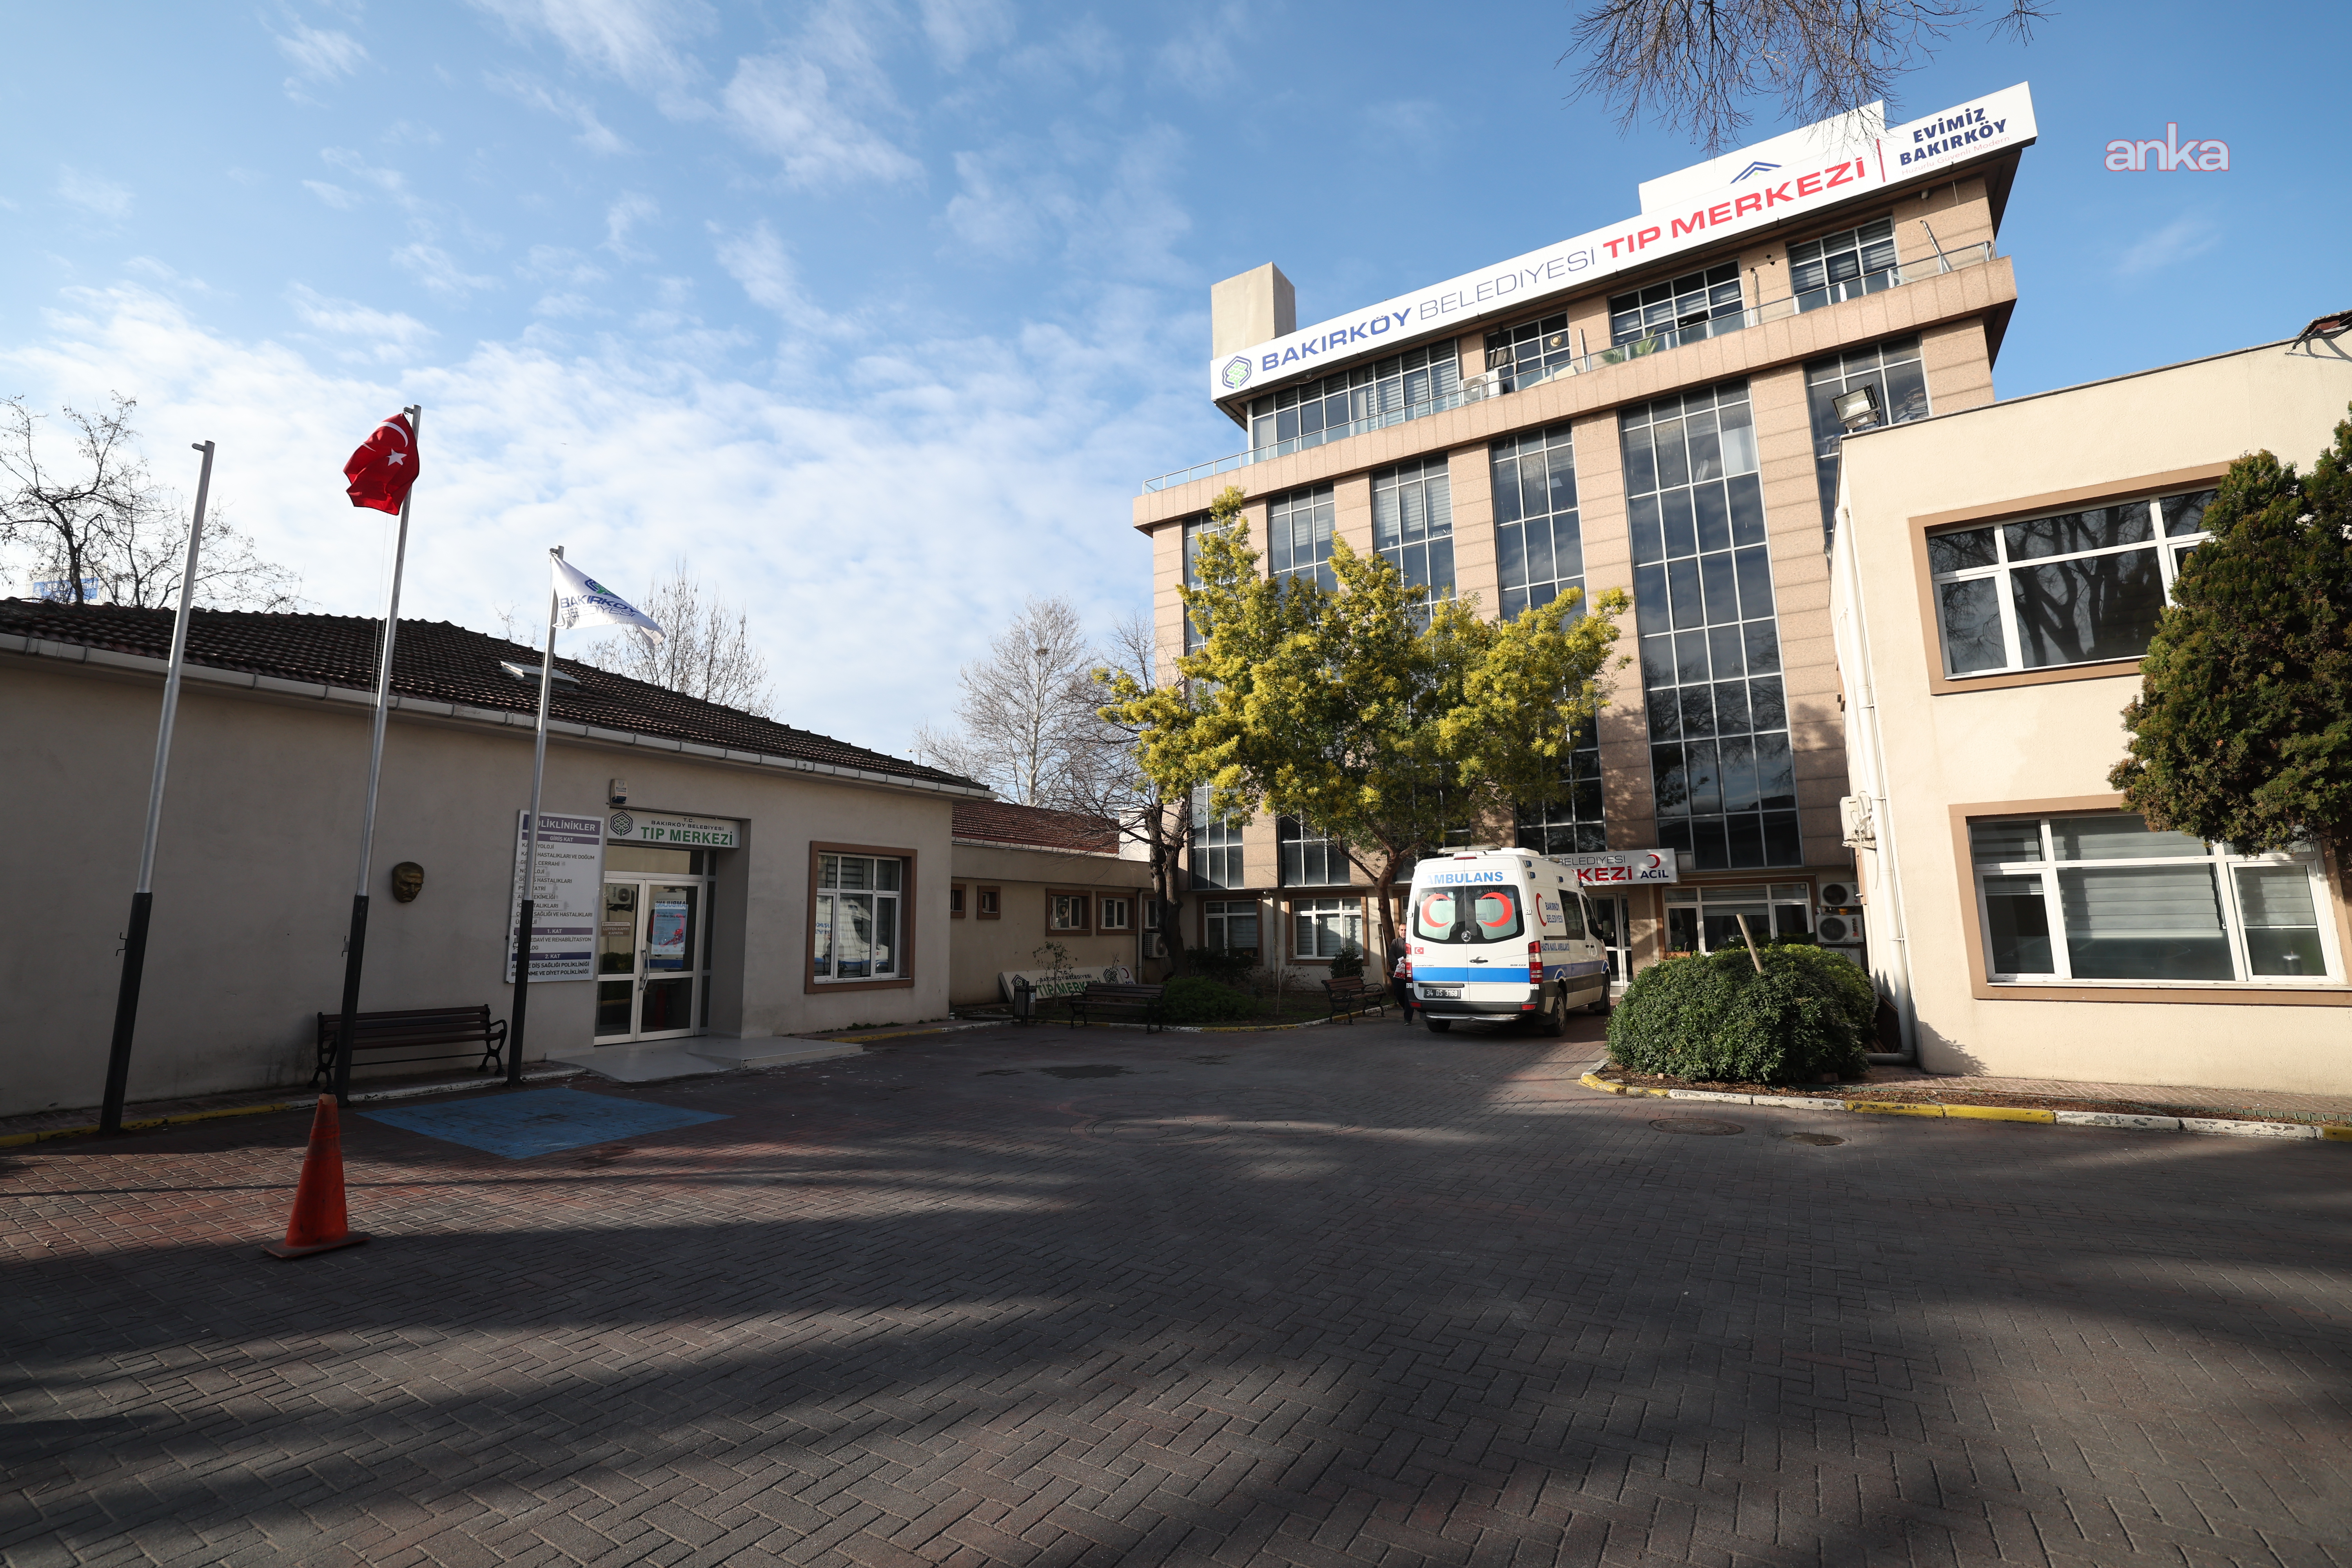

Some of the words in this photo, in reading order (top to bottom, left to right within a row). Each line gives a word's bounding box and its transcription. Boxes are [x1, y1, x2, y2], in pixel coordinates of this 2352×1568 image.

[1913, 108, 1986, 143] EVİMİZ
[1900, 118, 2007, 166] BAKIRKÖY
[1902, 162, 1935, 176] Huzurlu
[1937, 149, 1971, 163] Güvenli
[1974, 136, 2010, 151] Modern
[1262, 307, 1412, 372] BAKIRKÖY
[1420, 247, 1595, 321] BELEDİYESİ
[1603, 226, 1661, 259] TIP
[1671, 156, 1865, 239] MERKEZİ
[538, 818, 595, 831] LİKLİNİKLER
[641, 826, 664, 840] TIP
[670, 829, 732, 846] MERKEZİ
[1426, 871, 1503, 884] AMBULANS
[1571, 866, 1633, 882] KEZİ
[1545, 901, 1560, 911] BAKIRKÖY
[1546, 913, 1563, 923] BELEDİYESİ
[1541, 943, 1550, 951] HASTA
[1036, 984, 1054, 996] TIP
